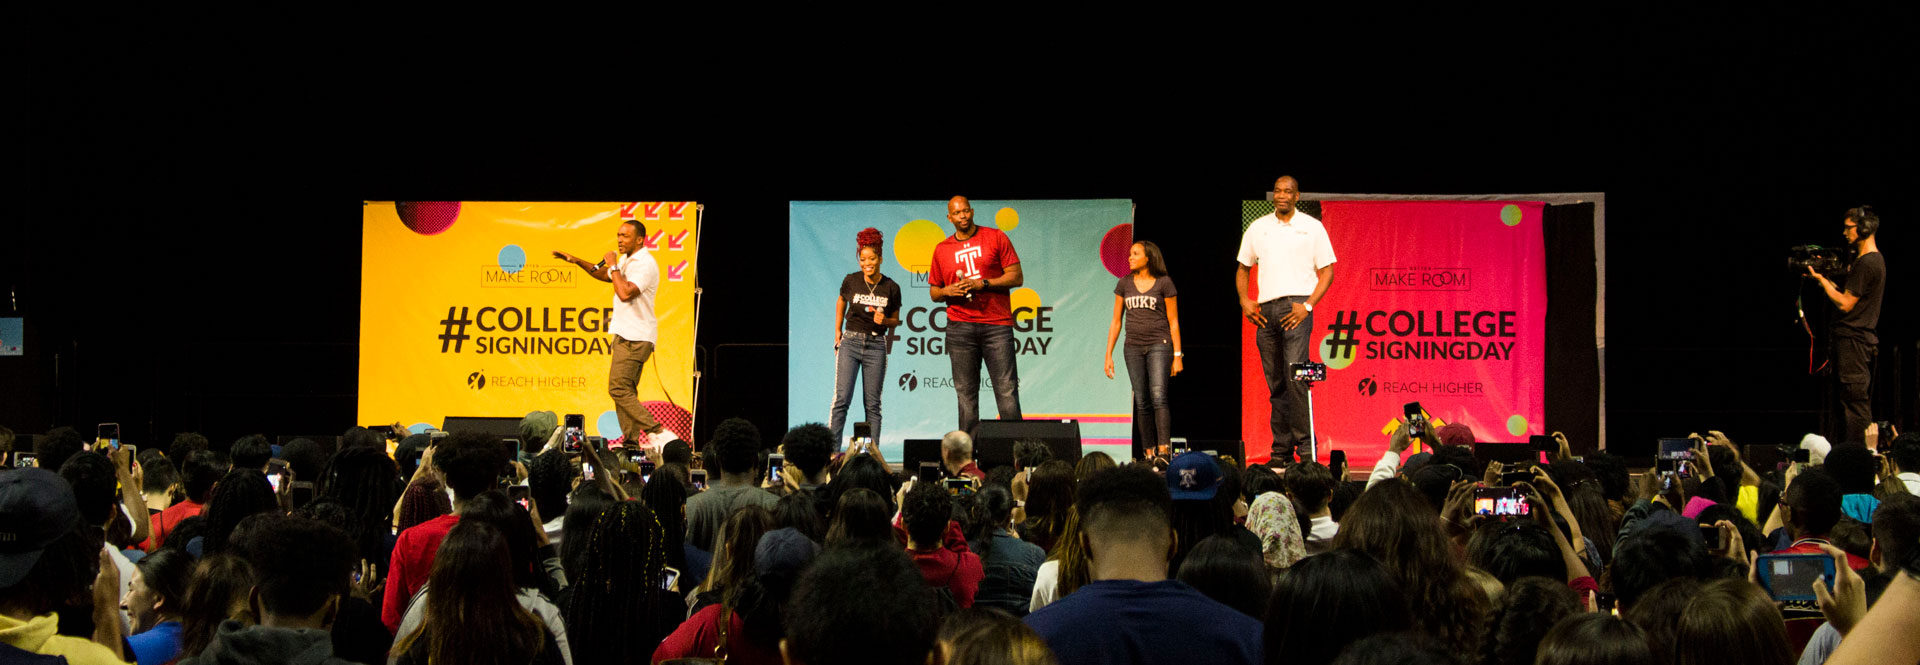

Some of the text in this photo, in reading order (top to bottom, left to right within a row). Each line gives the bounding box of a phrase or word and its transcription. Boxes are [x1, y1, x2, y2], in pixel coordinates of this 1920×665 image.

[486, 268, 572, 284] MAKE ROOM
[1375, 271, 1466, 288] MAKE ROOM
[1125, 295, 1157, 310] DUKE
[1325, 310, 1517, 360] #COLLEGE
[1365, 341, 1516, 361] SIGNINGDAY
[491, 375, 586, 388] REACH HIGHER
[1383, 382, 1483, 394] REACH HIGHER
